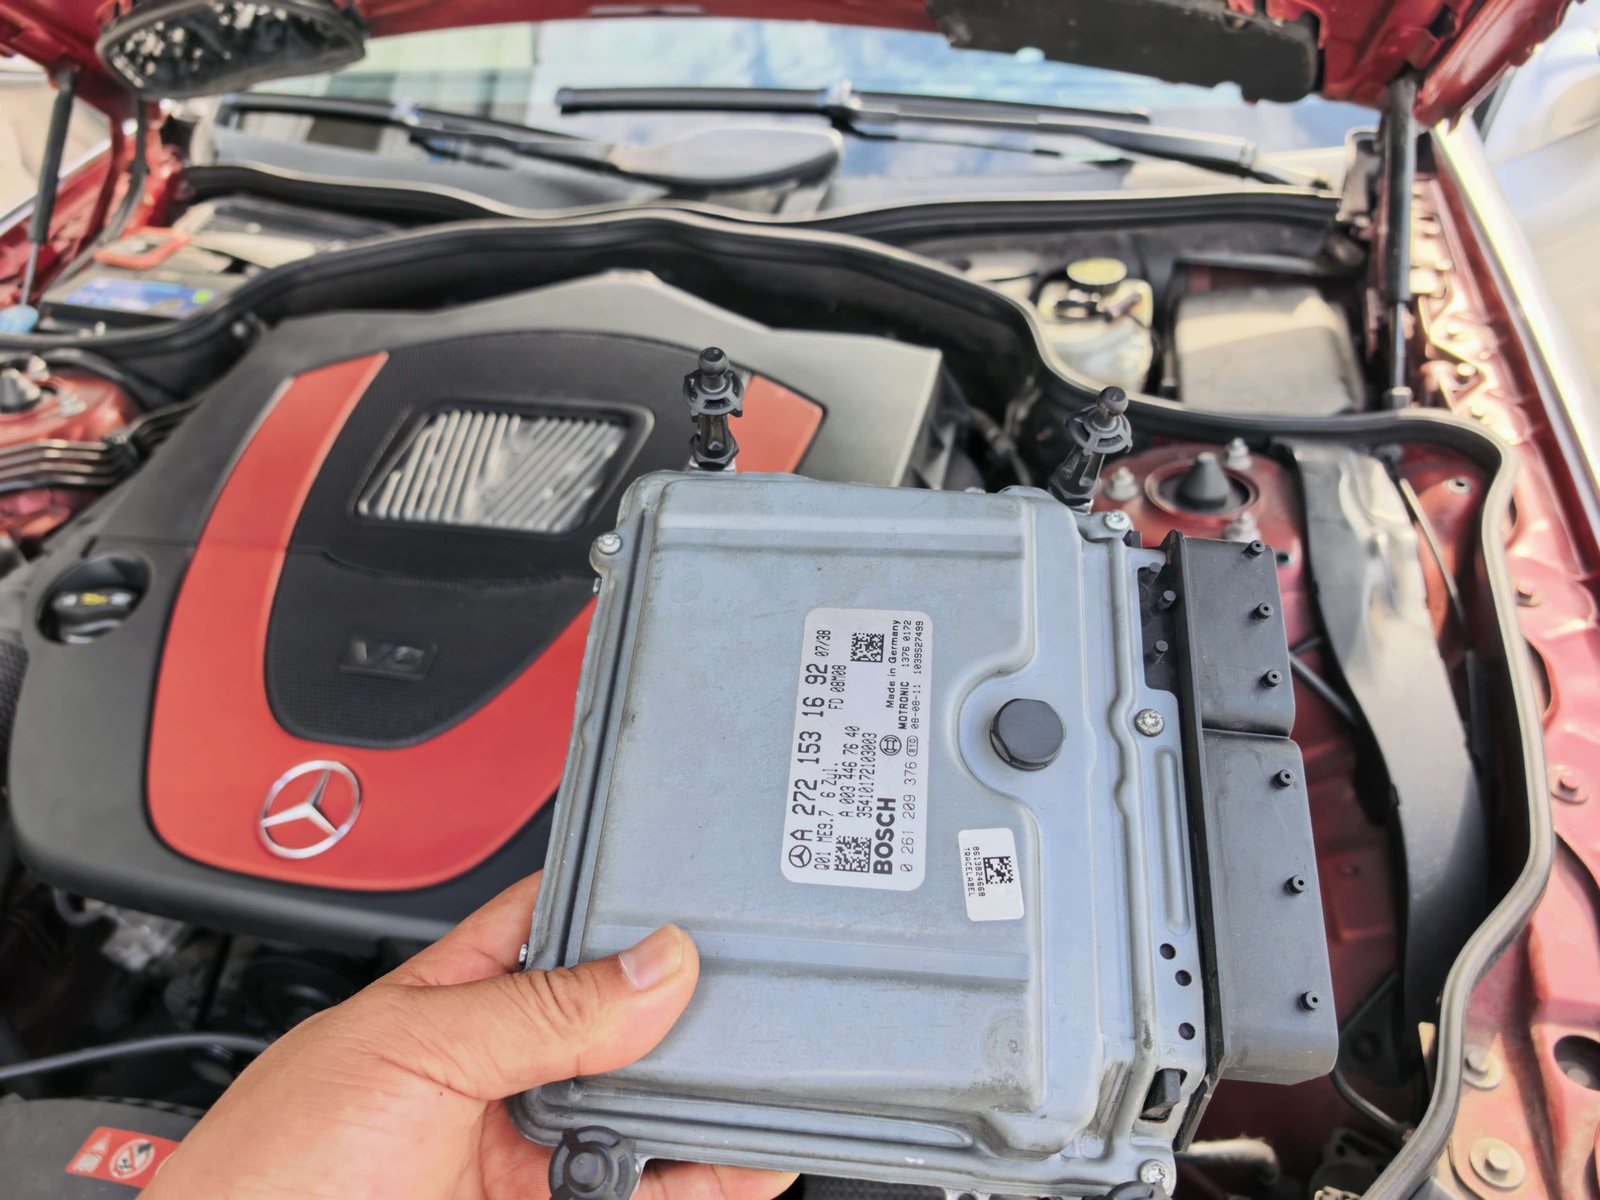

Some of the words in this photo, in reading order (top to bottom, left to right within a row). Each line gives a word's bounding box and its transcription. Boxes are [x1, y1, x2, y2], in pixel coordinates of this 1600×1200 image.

[815, 629, 831, 656] 07/38
[888, 620, 900, 663] Germany
[903, 620, 911, 641] 0172
[902, 646, 910, 667] 1376
[914, 620, 924, 674] 1039S27499
[805, 664, 828, 685] 92
[830, 665, 846, 692] 08M08
[888, 667, 896, 677] in
[828, 698, 844, 710] FD
[886, 681, 896, 708] Made
[898, 681, 909, 729] MOTRONIC
[911, 684, 921, 729] 08-08-11
[802, 697, 825, 717] 16
[845, 726, 860, 738] 40
[797, 731, 821, 764] 153
[843, 743, 859, 755] 76
[821, 763, 841, 785] Zyl.
[841, 762, 857, 780] 446
[857, 733, 877, 818] 35410172103003
[904, 762, 917, 785] 376
[792, 779, 818, 816] 272
[839, 786, 855, 804] 003
[903, 794, 916, 819] 209
[789, 829, 813, 841] A
[817, 810, 834, 843] ME9.7
[873, 797, 896, 875] BOSCH
[901, 830, 914, 854] 261
[900, 864, 913, 872] 0
[963, 847, 976, 897] TRACELABEL
[972, 846, 986, 897] 8613824668
